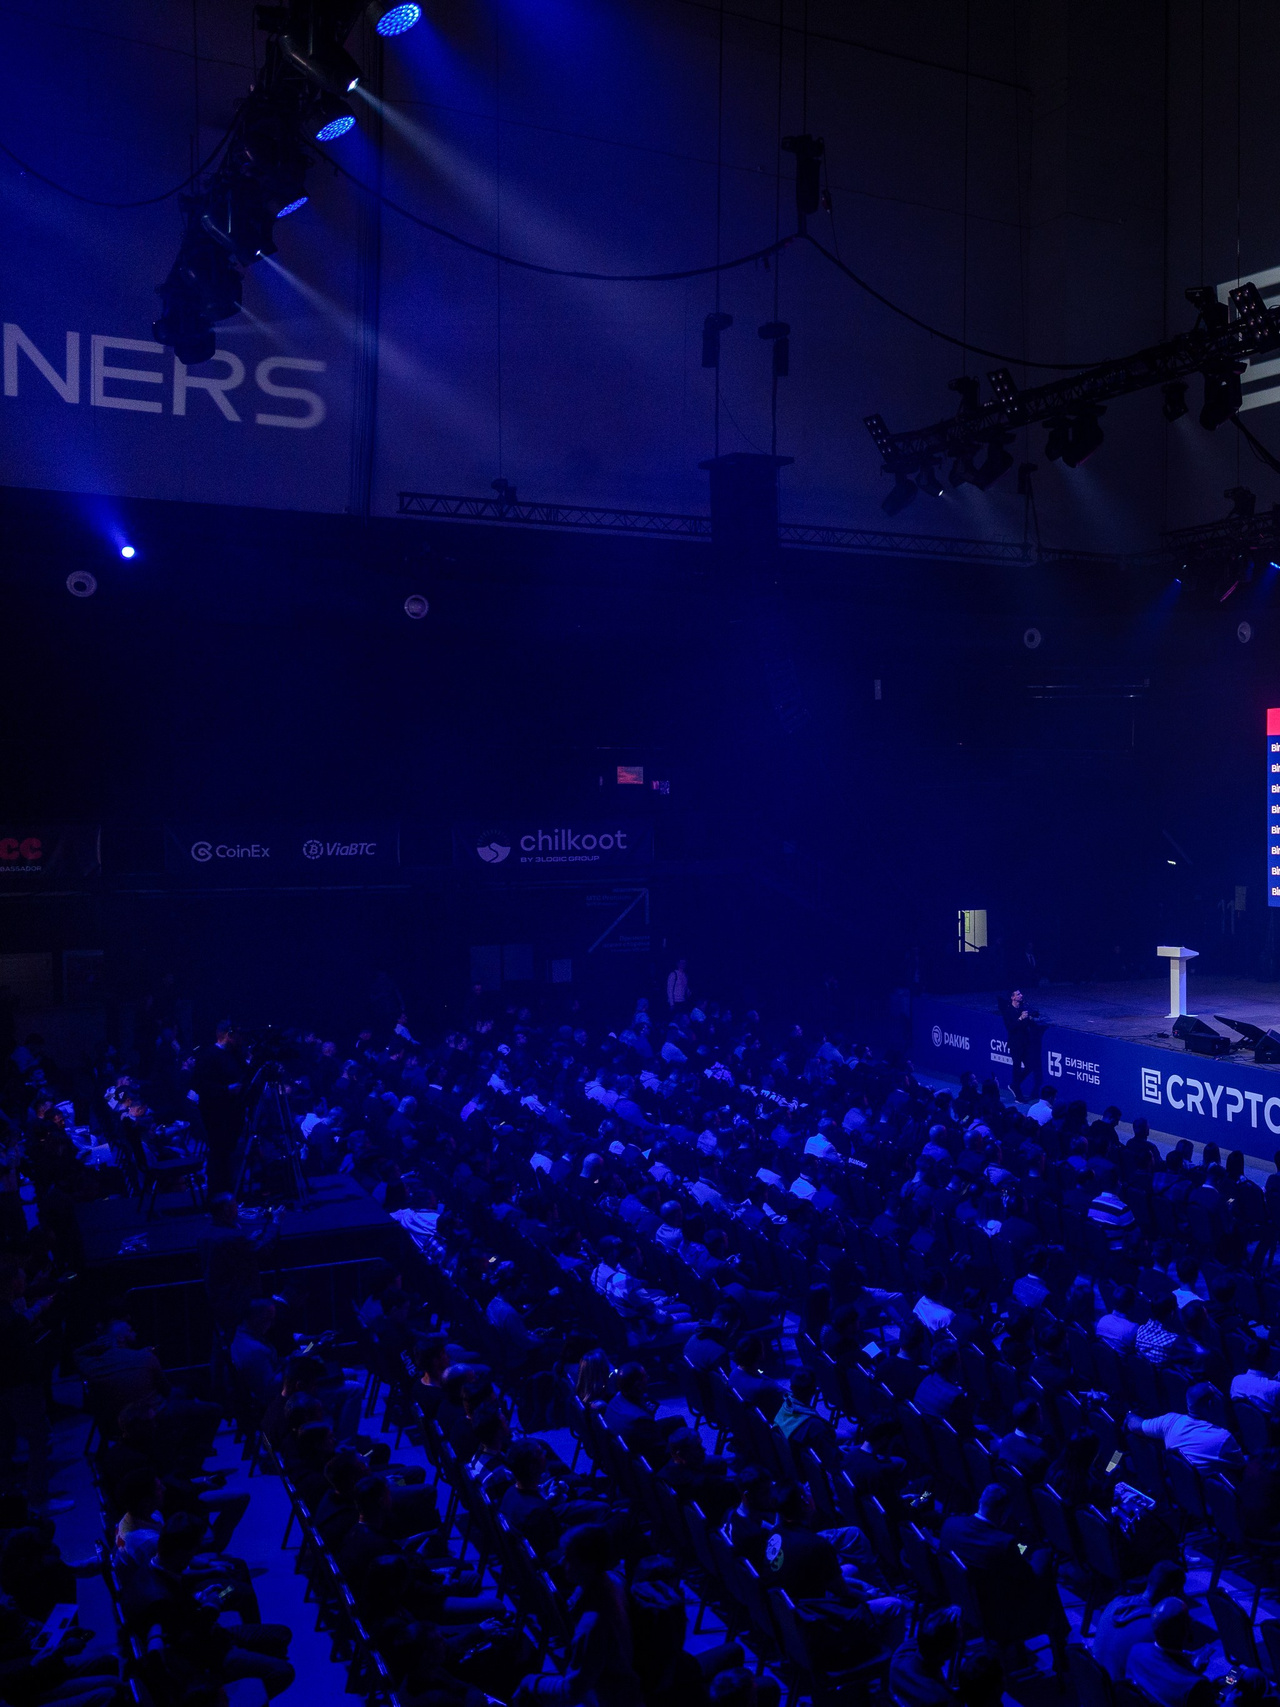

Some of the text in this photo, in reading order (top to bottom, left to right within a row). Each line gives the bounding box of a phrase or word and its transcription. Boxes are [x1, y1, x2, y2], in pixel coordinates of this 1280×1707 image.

[520, 828, 628, 851] chilkoot
[215, 843, 270, 859] CoinEx
[326, 842, 377, 857] ViaBTC
[944, 1032, 970, 1050] РАКИБ
[1065, 1057, 1101, 1073] БИЗНЕС
